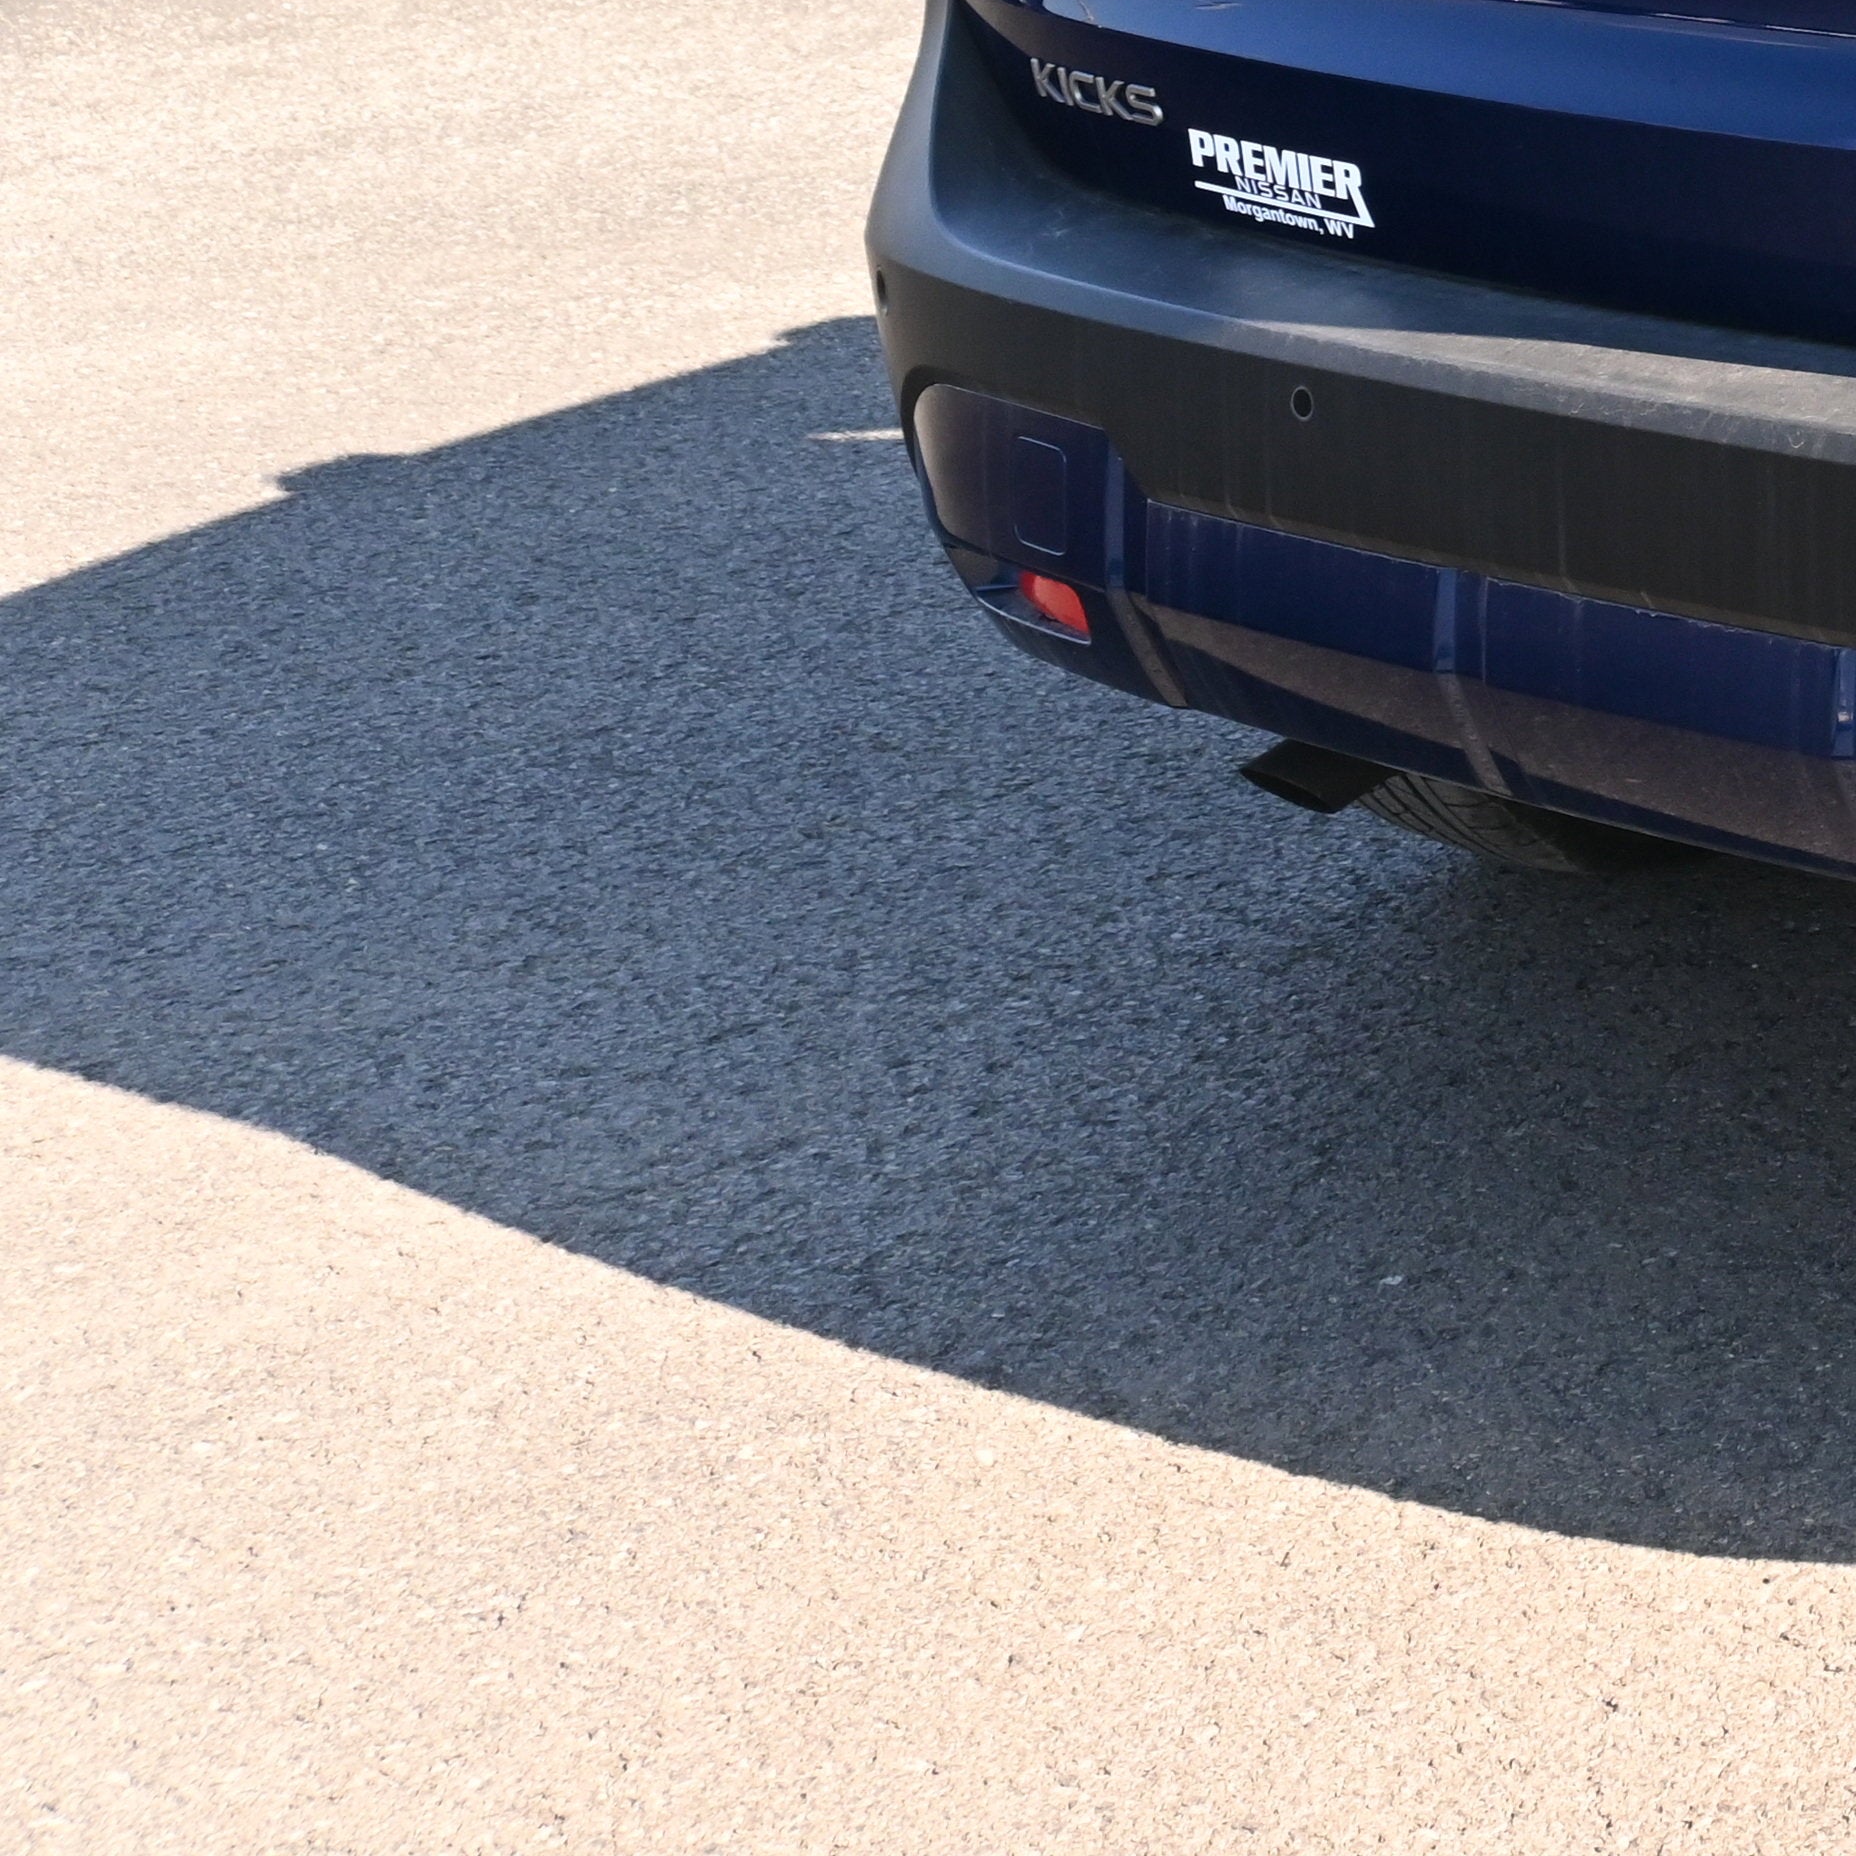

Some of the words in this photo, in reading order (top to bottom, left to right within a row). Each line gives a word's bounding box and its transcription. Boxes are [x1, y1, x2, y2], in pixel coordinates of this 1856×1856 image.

[1030, 57, 1165, 127] KICKS
[1188, 128, 1363, 200] PREMIER
[1223, 194, 1325, 235] Morgantown,
[1323, 219, 1355, 239] WV
[1235, 176, 1322, 210] NISSAN
